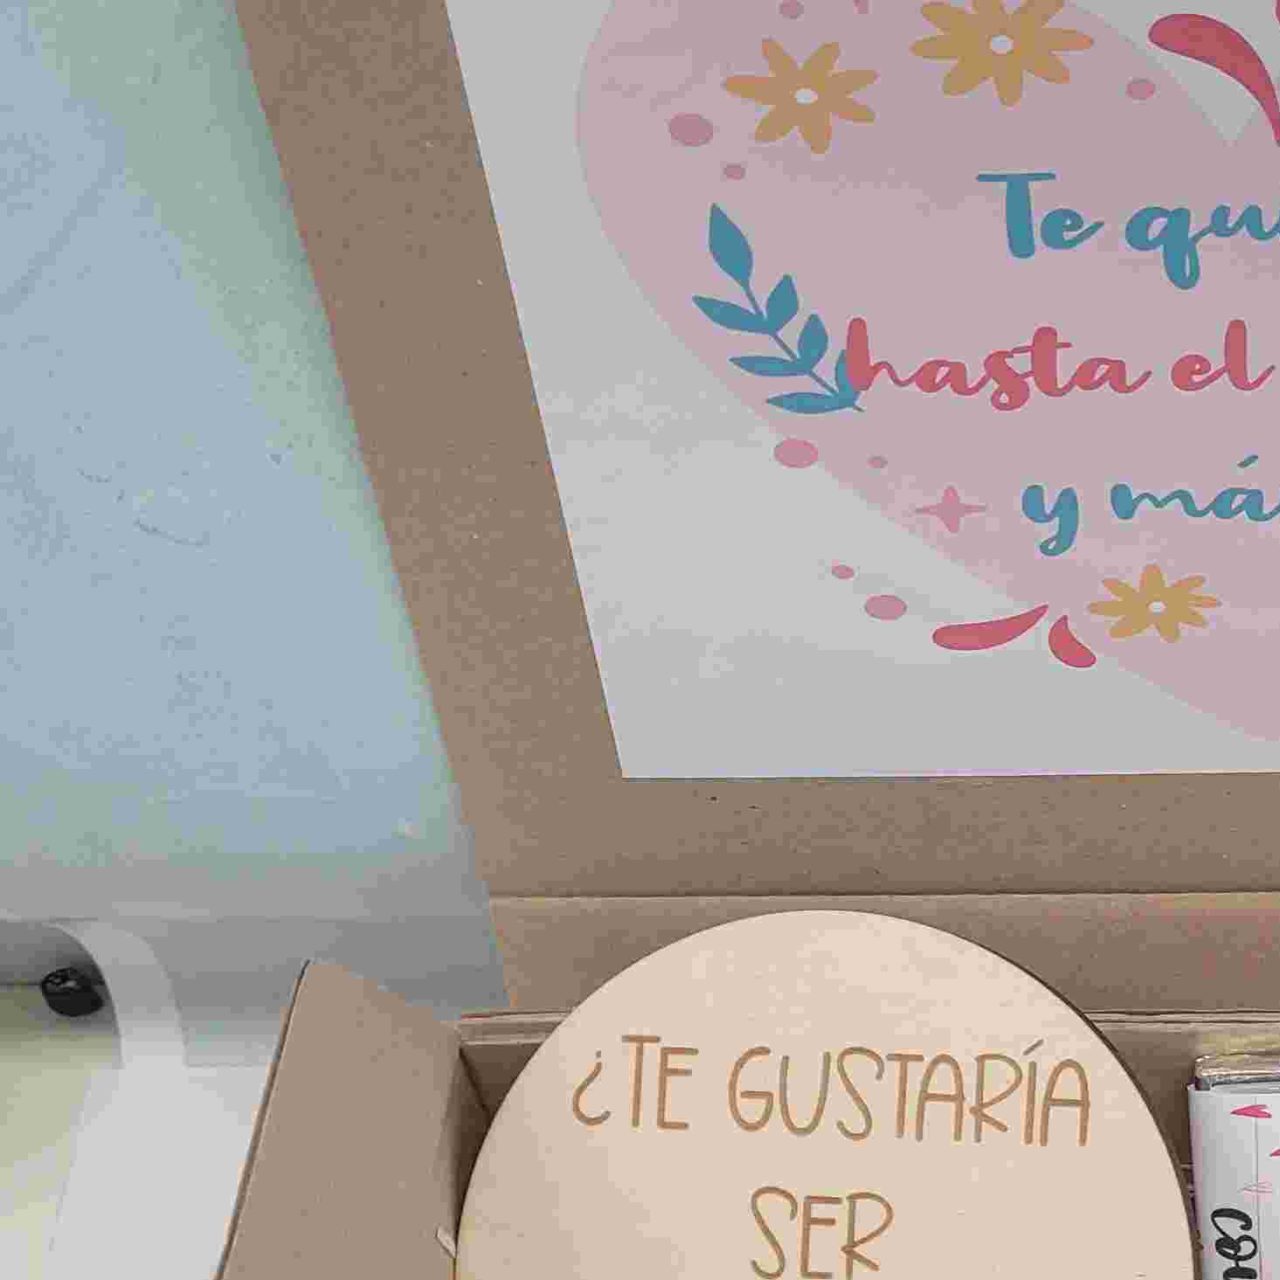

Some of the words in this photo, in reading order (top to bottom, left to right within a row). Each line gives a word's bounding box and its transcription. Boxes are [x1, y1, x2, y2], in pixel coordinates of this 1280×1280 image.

[976, 172, 1104, 259] Te
[845, 317, 1153, 412] hasta
[1170, 319, 1276, 393] el
[1021, 482, 1079, 557] y
[571, 1034, 700, 1132] ¿TE
[727, 1038, 1092, 1147] GUSTARÍA
